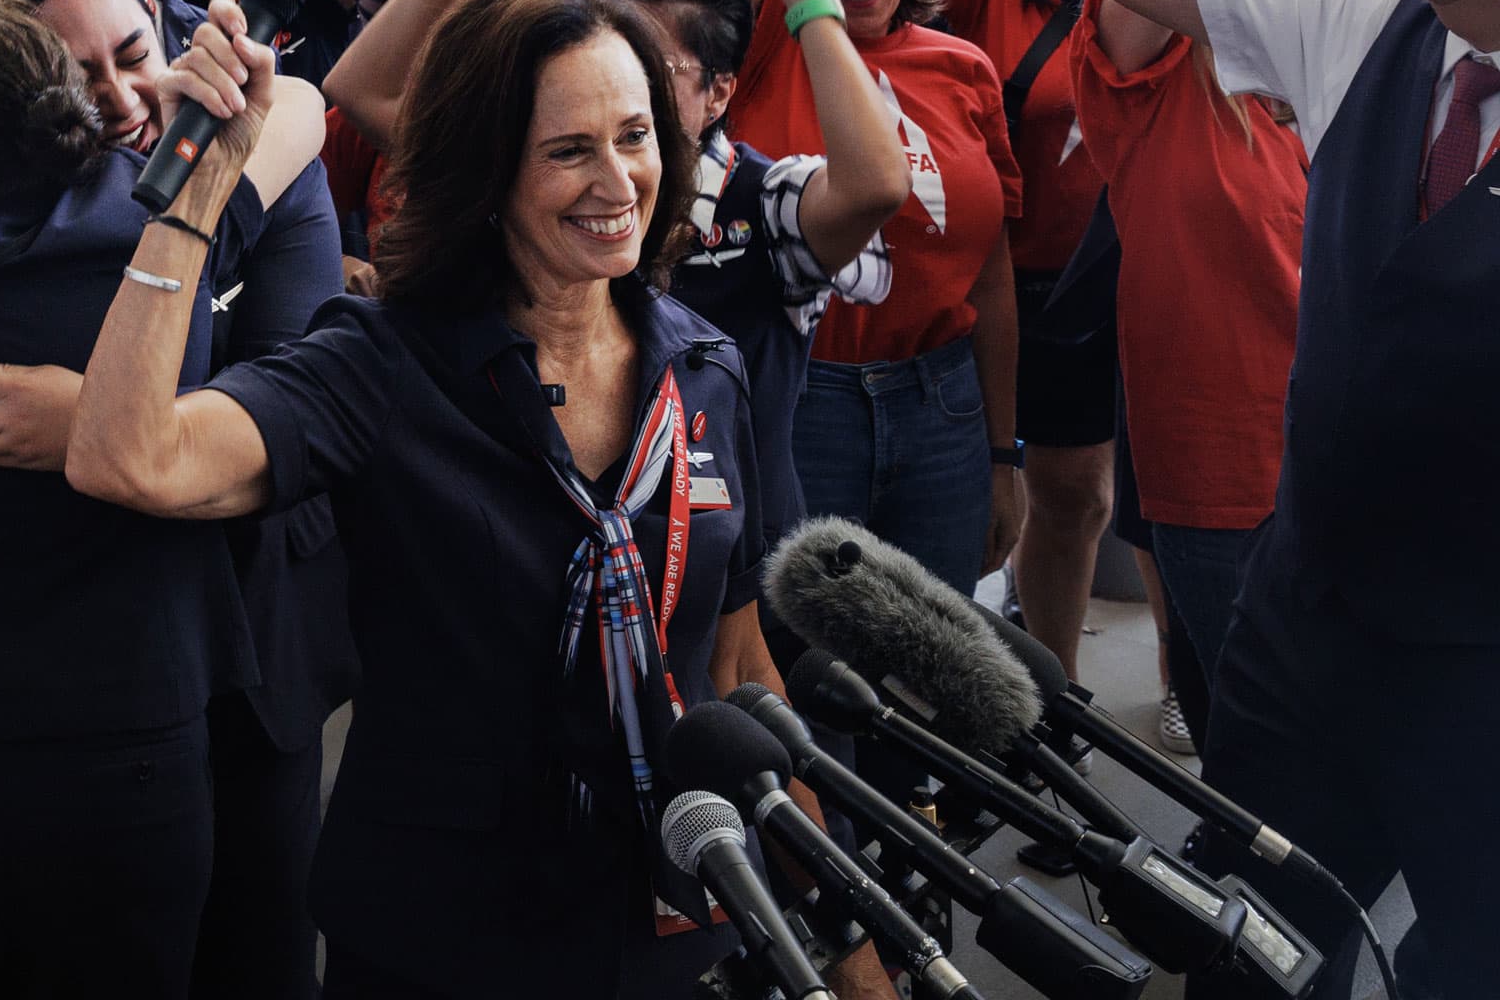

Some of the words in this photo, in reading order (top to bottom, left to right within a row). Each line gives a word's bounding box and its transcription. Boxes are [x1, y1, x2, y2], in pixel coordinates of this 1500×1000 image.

[675, 412, 684, 429] WE
[675, 430, 685, 454] ARE
[675, 456, 685, 497] READY
[669, 531, 682, 551] WE
[667, 555, 682, 580] ARE
[657, 581, 677, 622] READY
